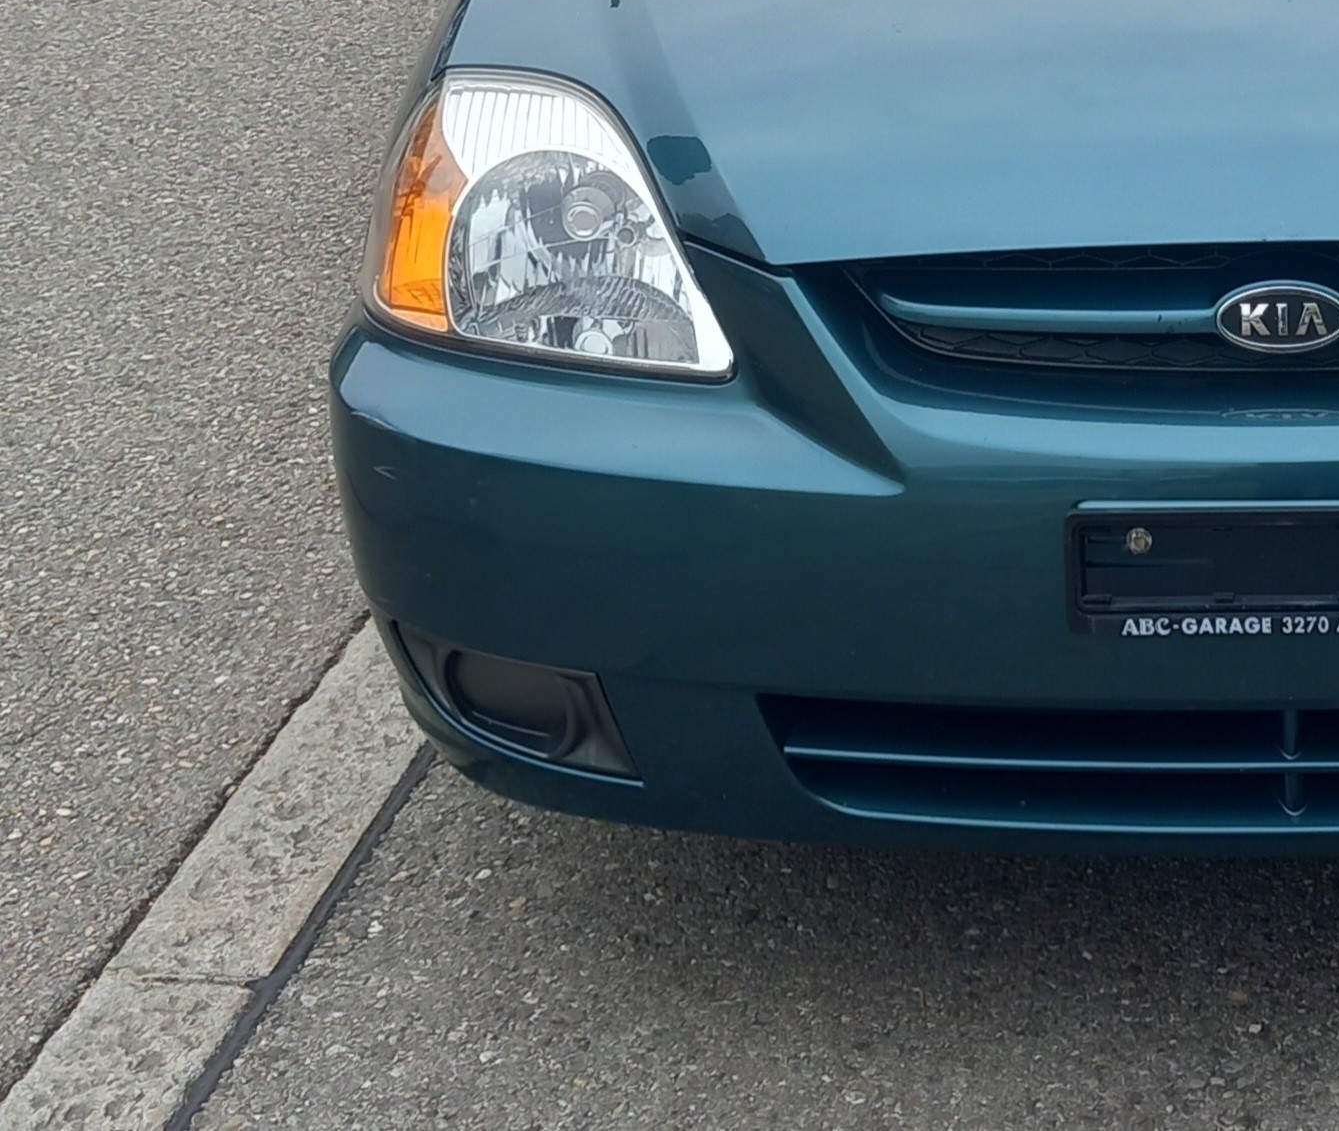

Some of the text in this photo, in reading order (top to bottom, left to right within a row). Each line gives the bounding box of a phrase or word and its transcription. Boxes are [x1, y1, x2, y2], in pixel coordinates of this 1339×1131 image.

[1239, 302, 1328, 336] KIA
[1121, 617, 1273, 637] ABC-GARAGE
[1281, 616, 1330, 635] 3270
